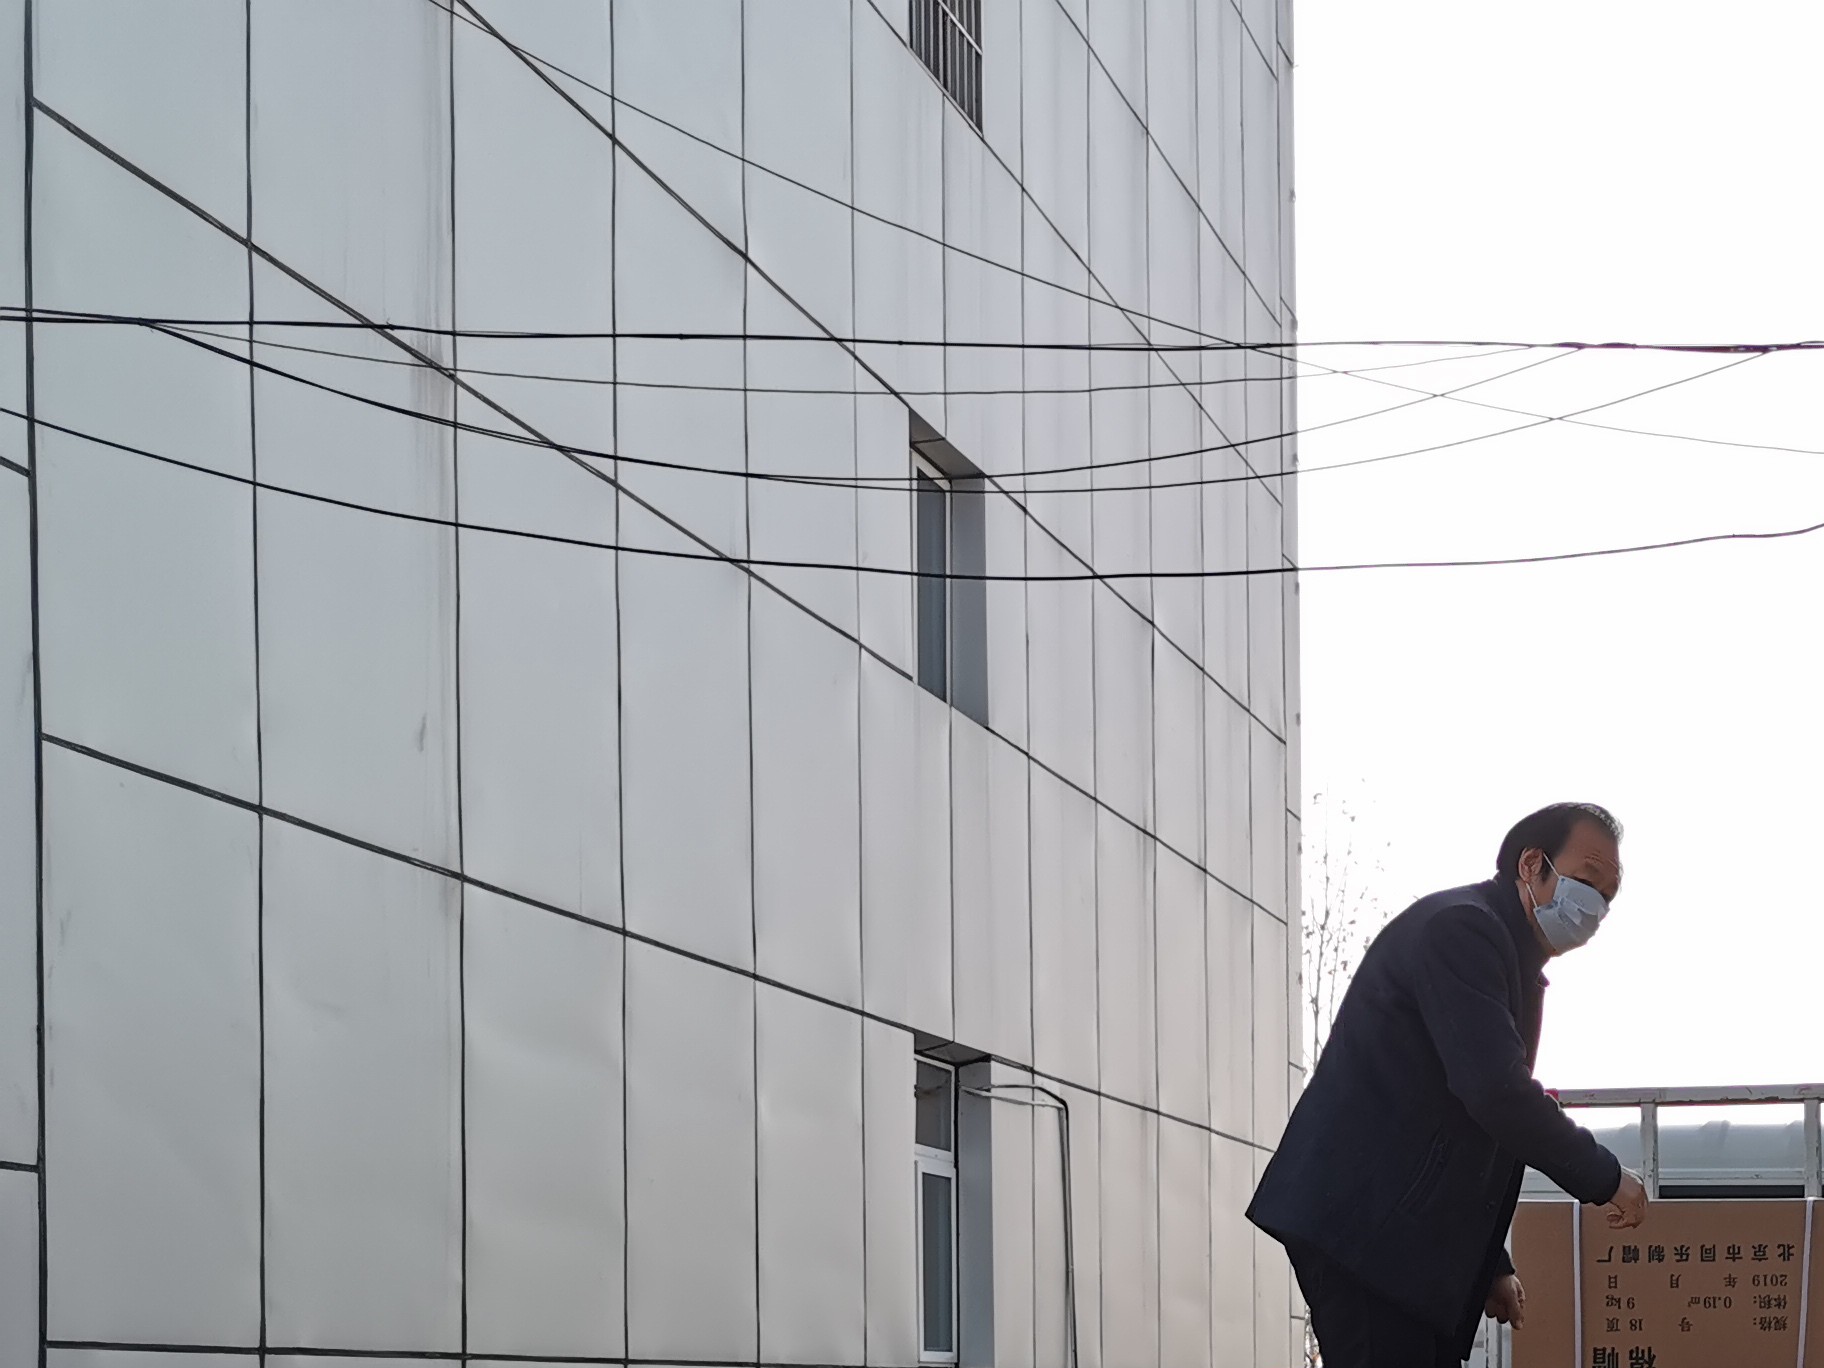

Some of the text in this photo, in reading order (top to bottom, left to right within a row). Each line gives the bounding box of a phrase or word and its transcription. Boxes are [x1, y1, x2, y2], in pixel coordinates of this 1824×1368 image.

[1595, 1243, 1795, 1264] 北京市同乐制帽厂
[1752, 1274, 1788, 1288] 2019
